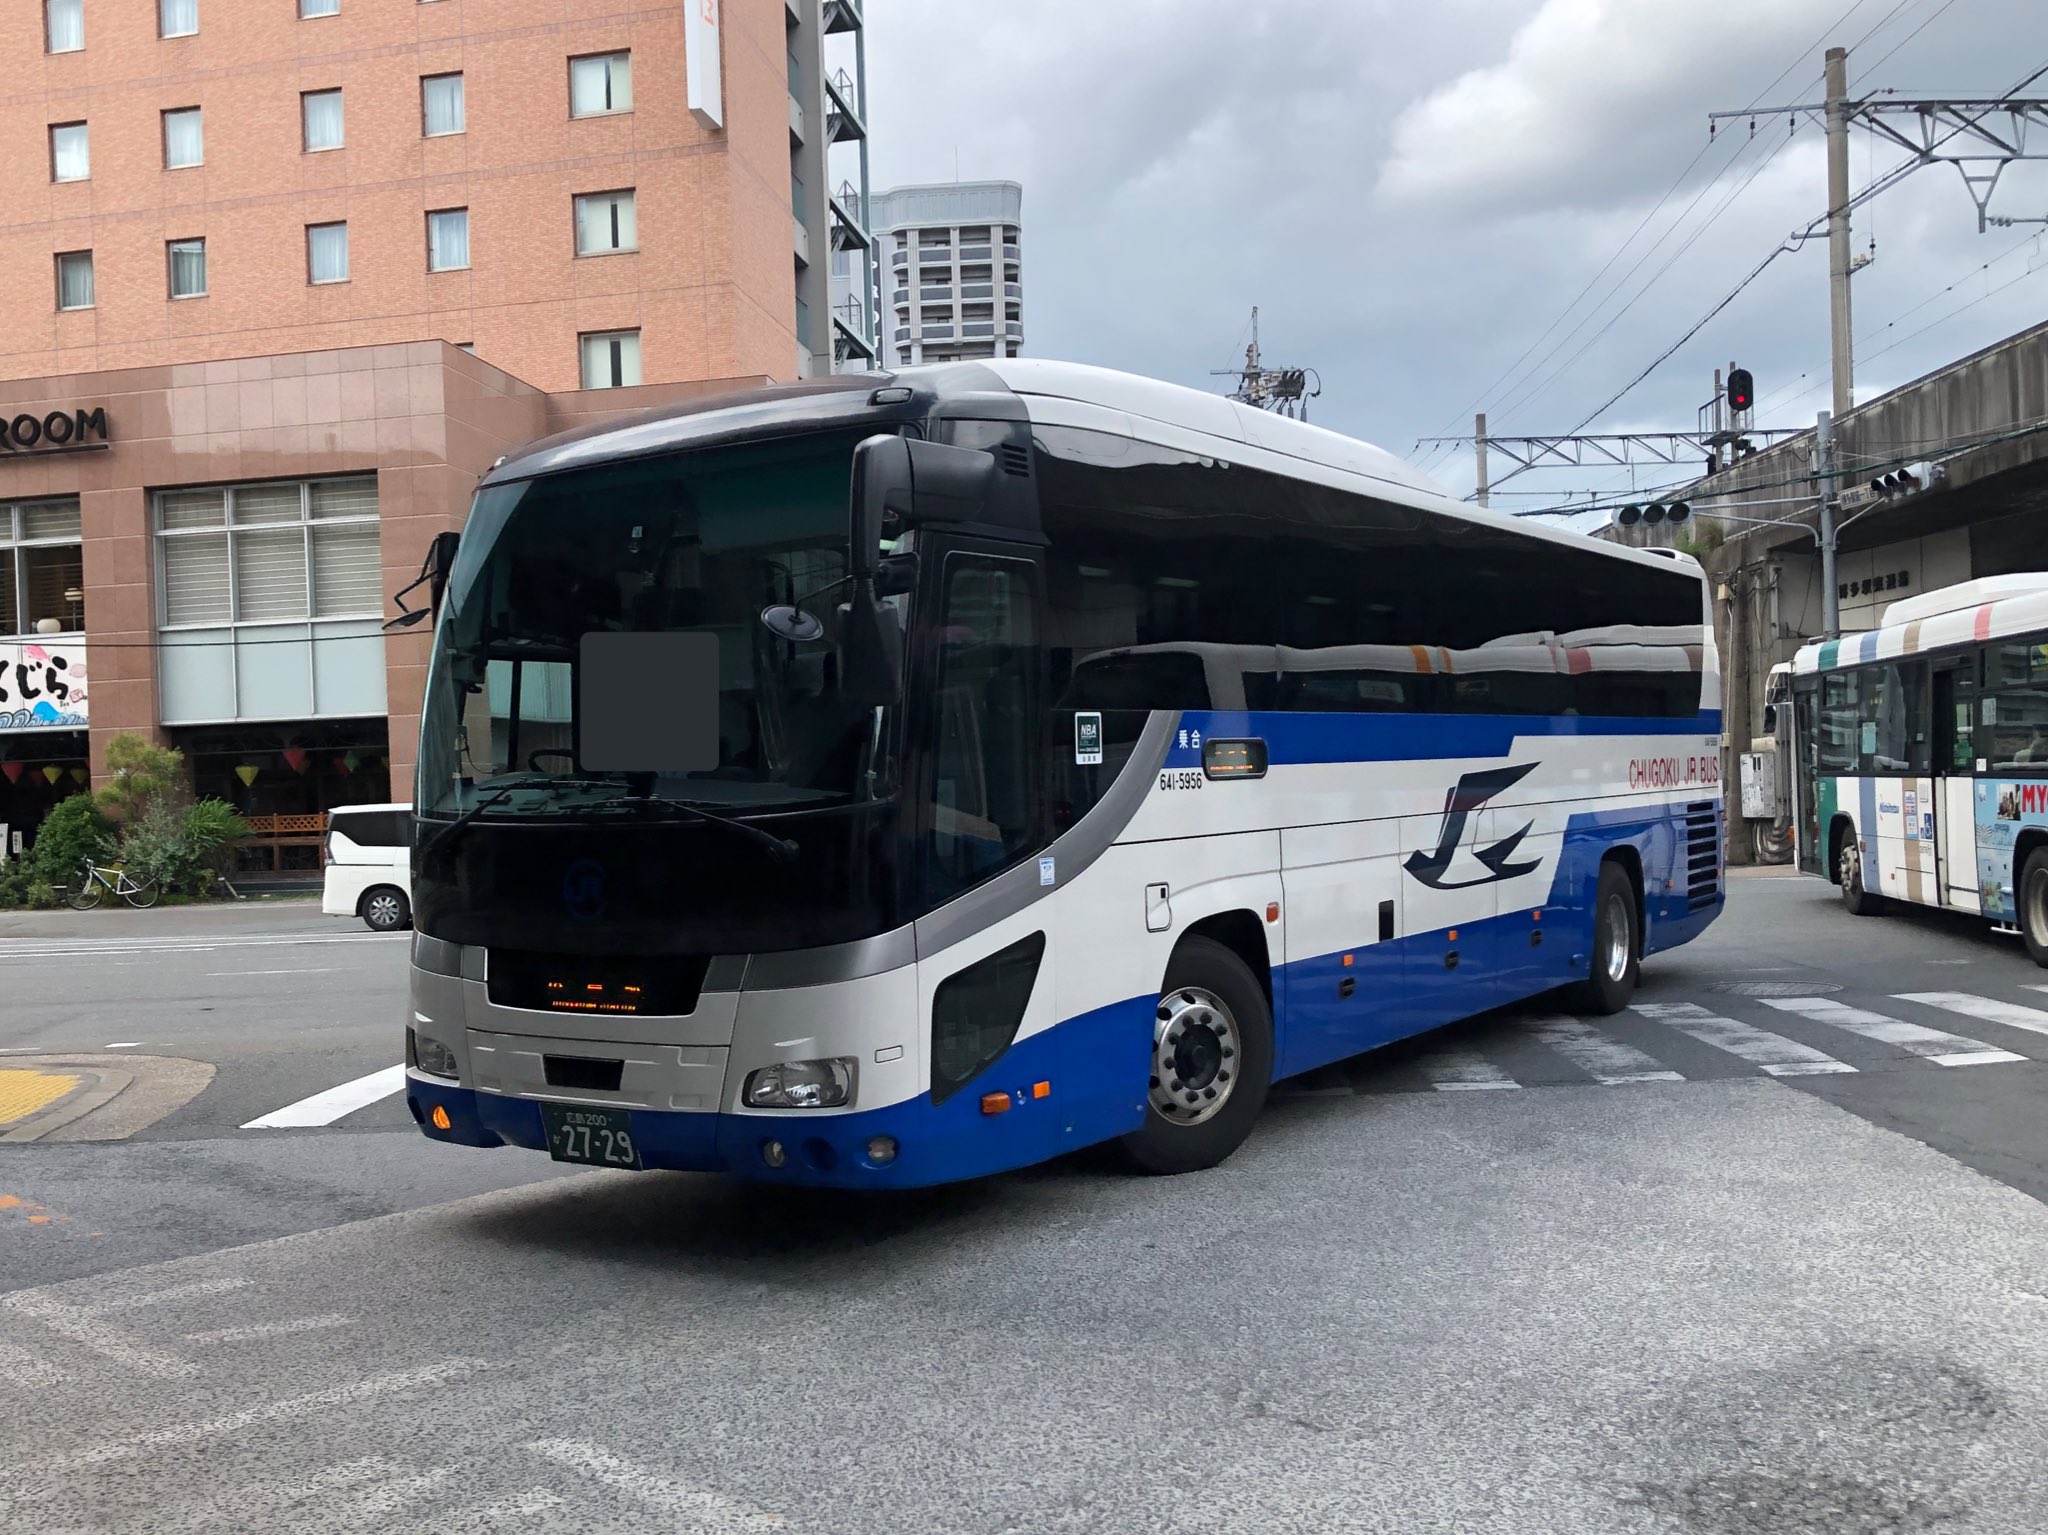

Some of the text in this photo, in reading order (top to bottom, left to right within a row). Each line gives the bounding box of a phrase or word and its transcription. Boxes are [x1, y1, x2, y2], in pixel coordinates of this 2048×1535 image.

[1179, 729, 1200, 749] 乗合
[1160, 772, 1202, 791] 641-5956
[1629, 755, 1718, 789] CHUGOKU JR BUS
[2022, 784, 2048, 814] MY
[562, 1125, 634, 1163] 27-29
